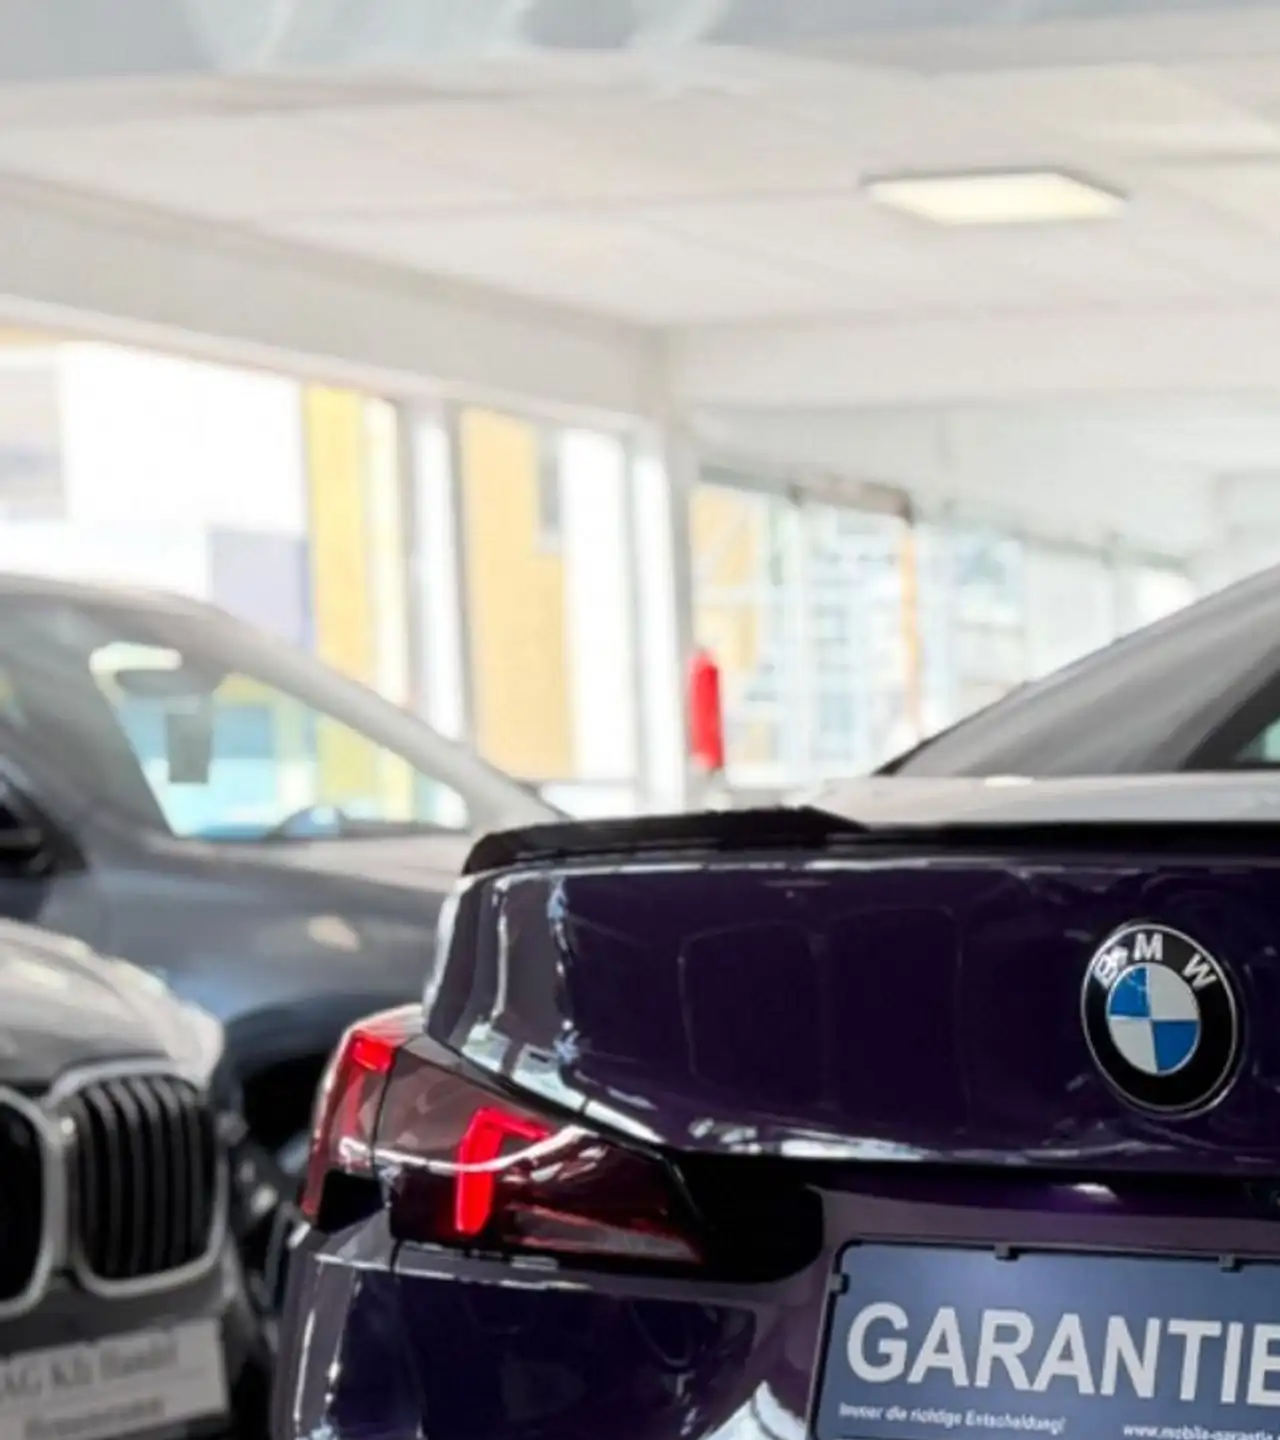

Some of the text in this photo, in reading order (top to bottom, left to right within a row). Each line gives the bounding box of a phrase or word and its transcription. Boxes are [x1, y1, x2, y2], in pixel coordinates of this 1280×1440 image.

[1094, 932, 1217, 992] BMW
[885, 1405, 907, 1421] die
[910, 1407, 962, 1428] richtige
